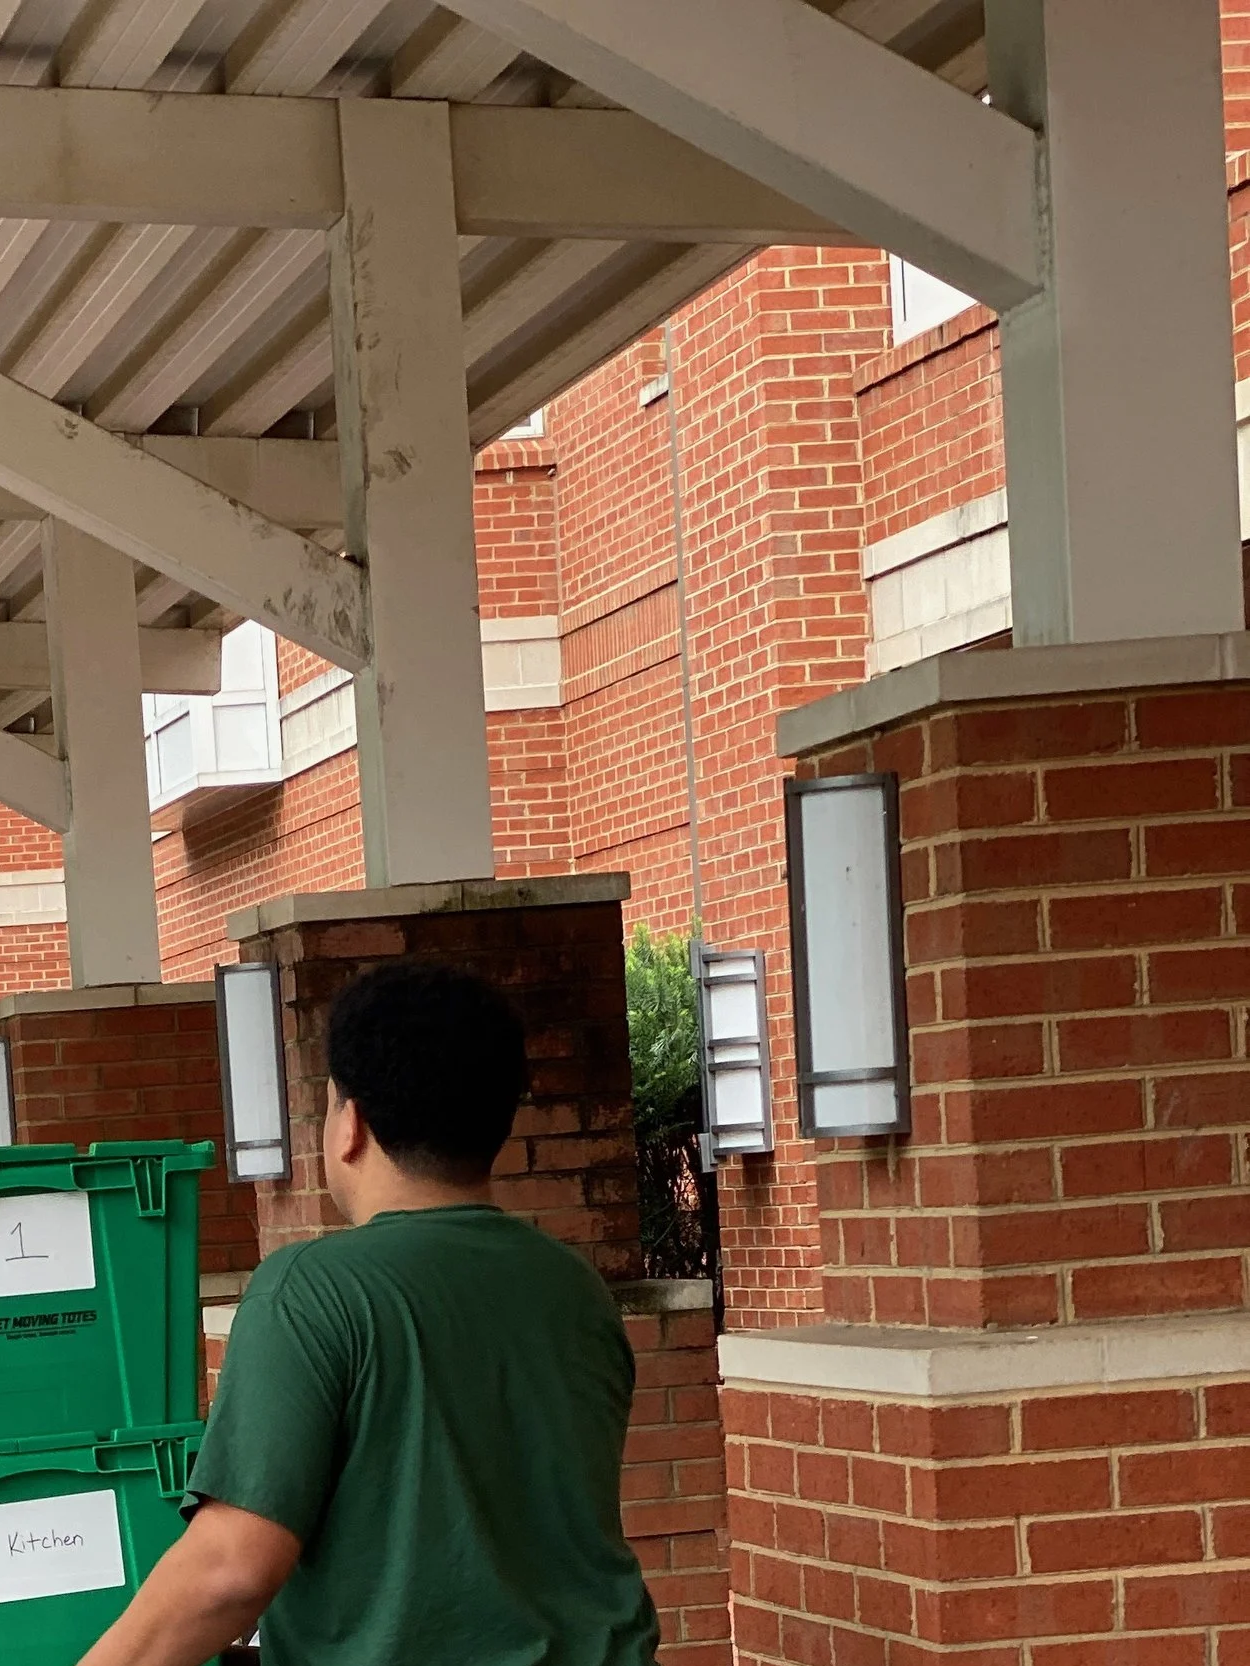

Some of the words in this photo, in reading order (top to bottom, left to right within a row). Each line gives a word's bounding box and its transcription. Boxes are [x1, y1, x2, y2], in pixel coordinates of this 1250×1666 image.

[12, 1313, 59, 1329] MOVING
[61, 1310, 97, 1324] TOTES
[8, 1529, 84, 1556] Kitchen
